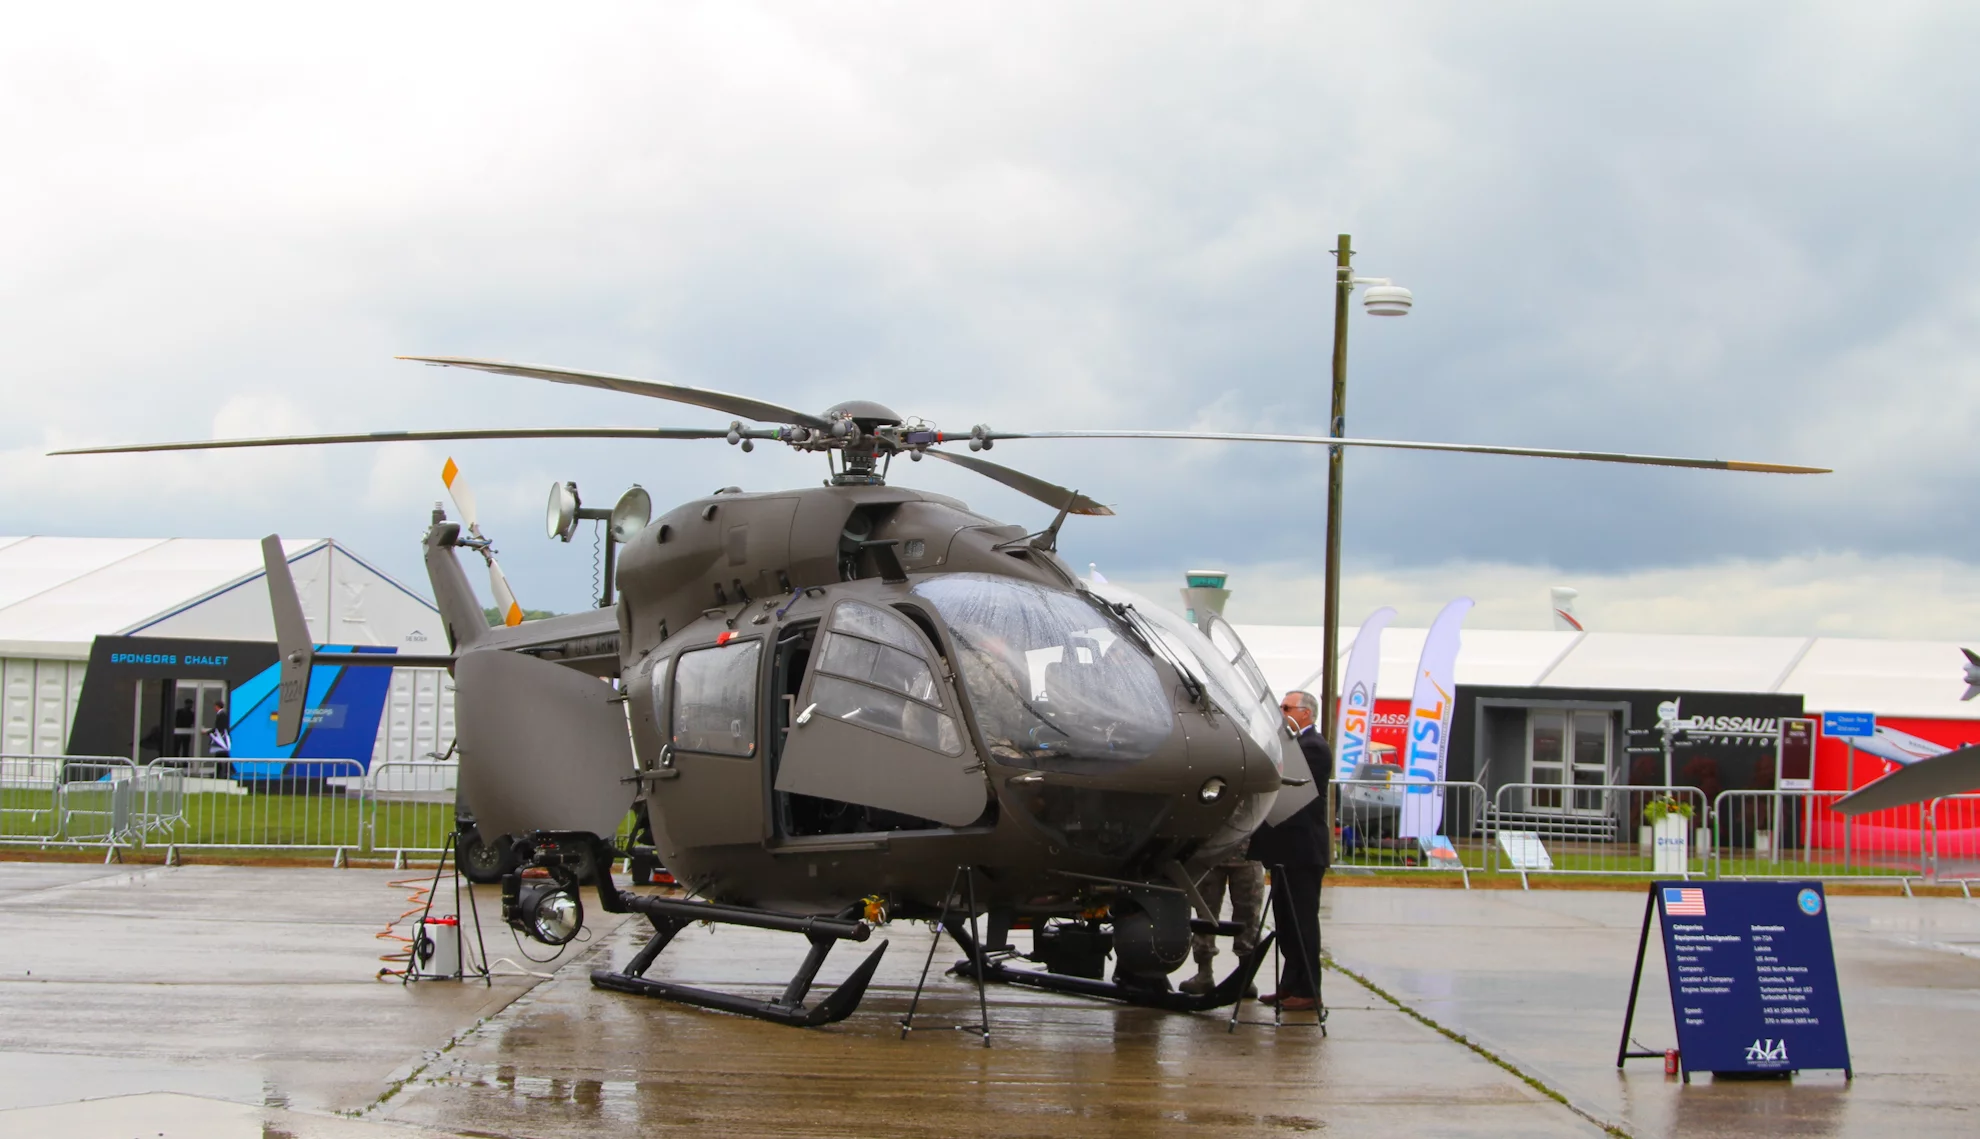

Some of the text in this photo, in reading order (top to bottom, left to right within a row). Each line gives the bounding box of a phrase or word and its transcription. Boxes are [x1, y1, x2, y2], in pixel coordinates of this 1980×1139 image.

[111, 653, 229, 666] SPONSORS CHALET
[1690, 715, 1778, 733] DASSAUL
[1408, 701, 1444, 795] UTSL
[1673, 924, 1704, 932] Categories
[1751, 924, 1785, 932] Information
[1674, 934, 1742, 943] Equipment Designation:
[1675, 944, 1713, 952] Popular Name:
[1764, 955, 1778, 963] Army
[1678, 965, 1705, 973] Company:
[1772, 965, 1787, 973] North
[1787, 965, 1808, 973] America
[1709, 976, 1735, 984] Company:
[1758, 976, 1785, 984] Columbus,
[1681, 986, 1731, 994] Engine Description:
[1761, 993, 1806, 1002] Turboshaft Engine
[1684, 1007, 1703, 1015] Speed:
[1686, 1017, 1705, 1026] Range:
[1764, 1017, 1776, 1025] 370
[1780, 1017, 1795, 1025] miles
[1745, 1038, 1788, 1061] AIA
